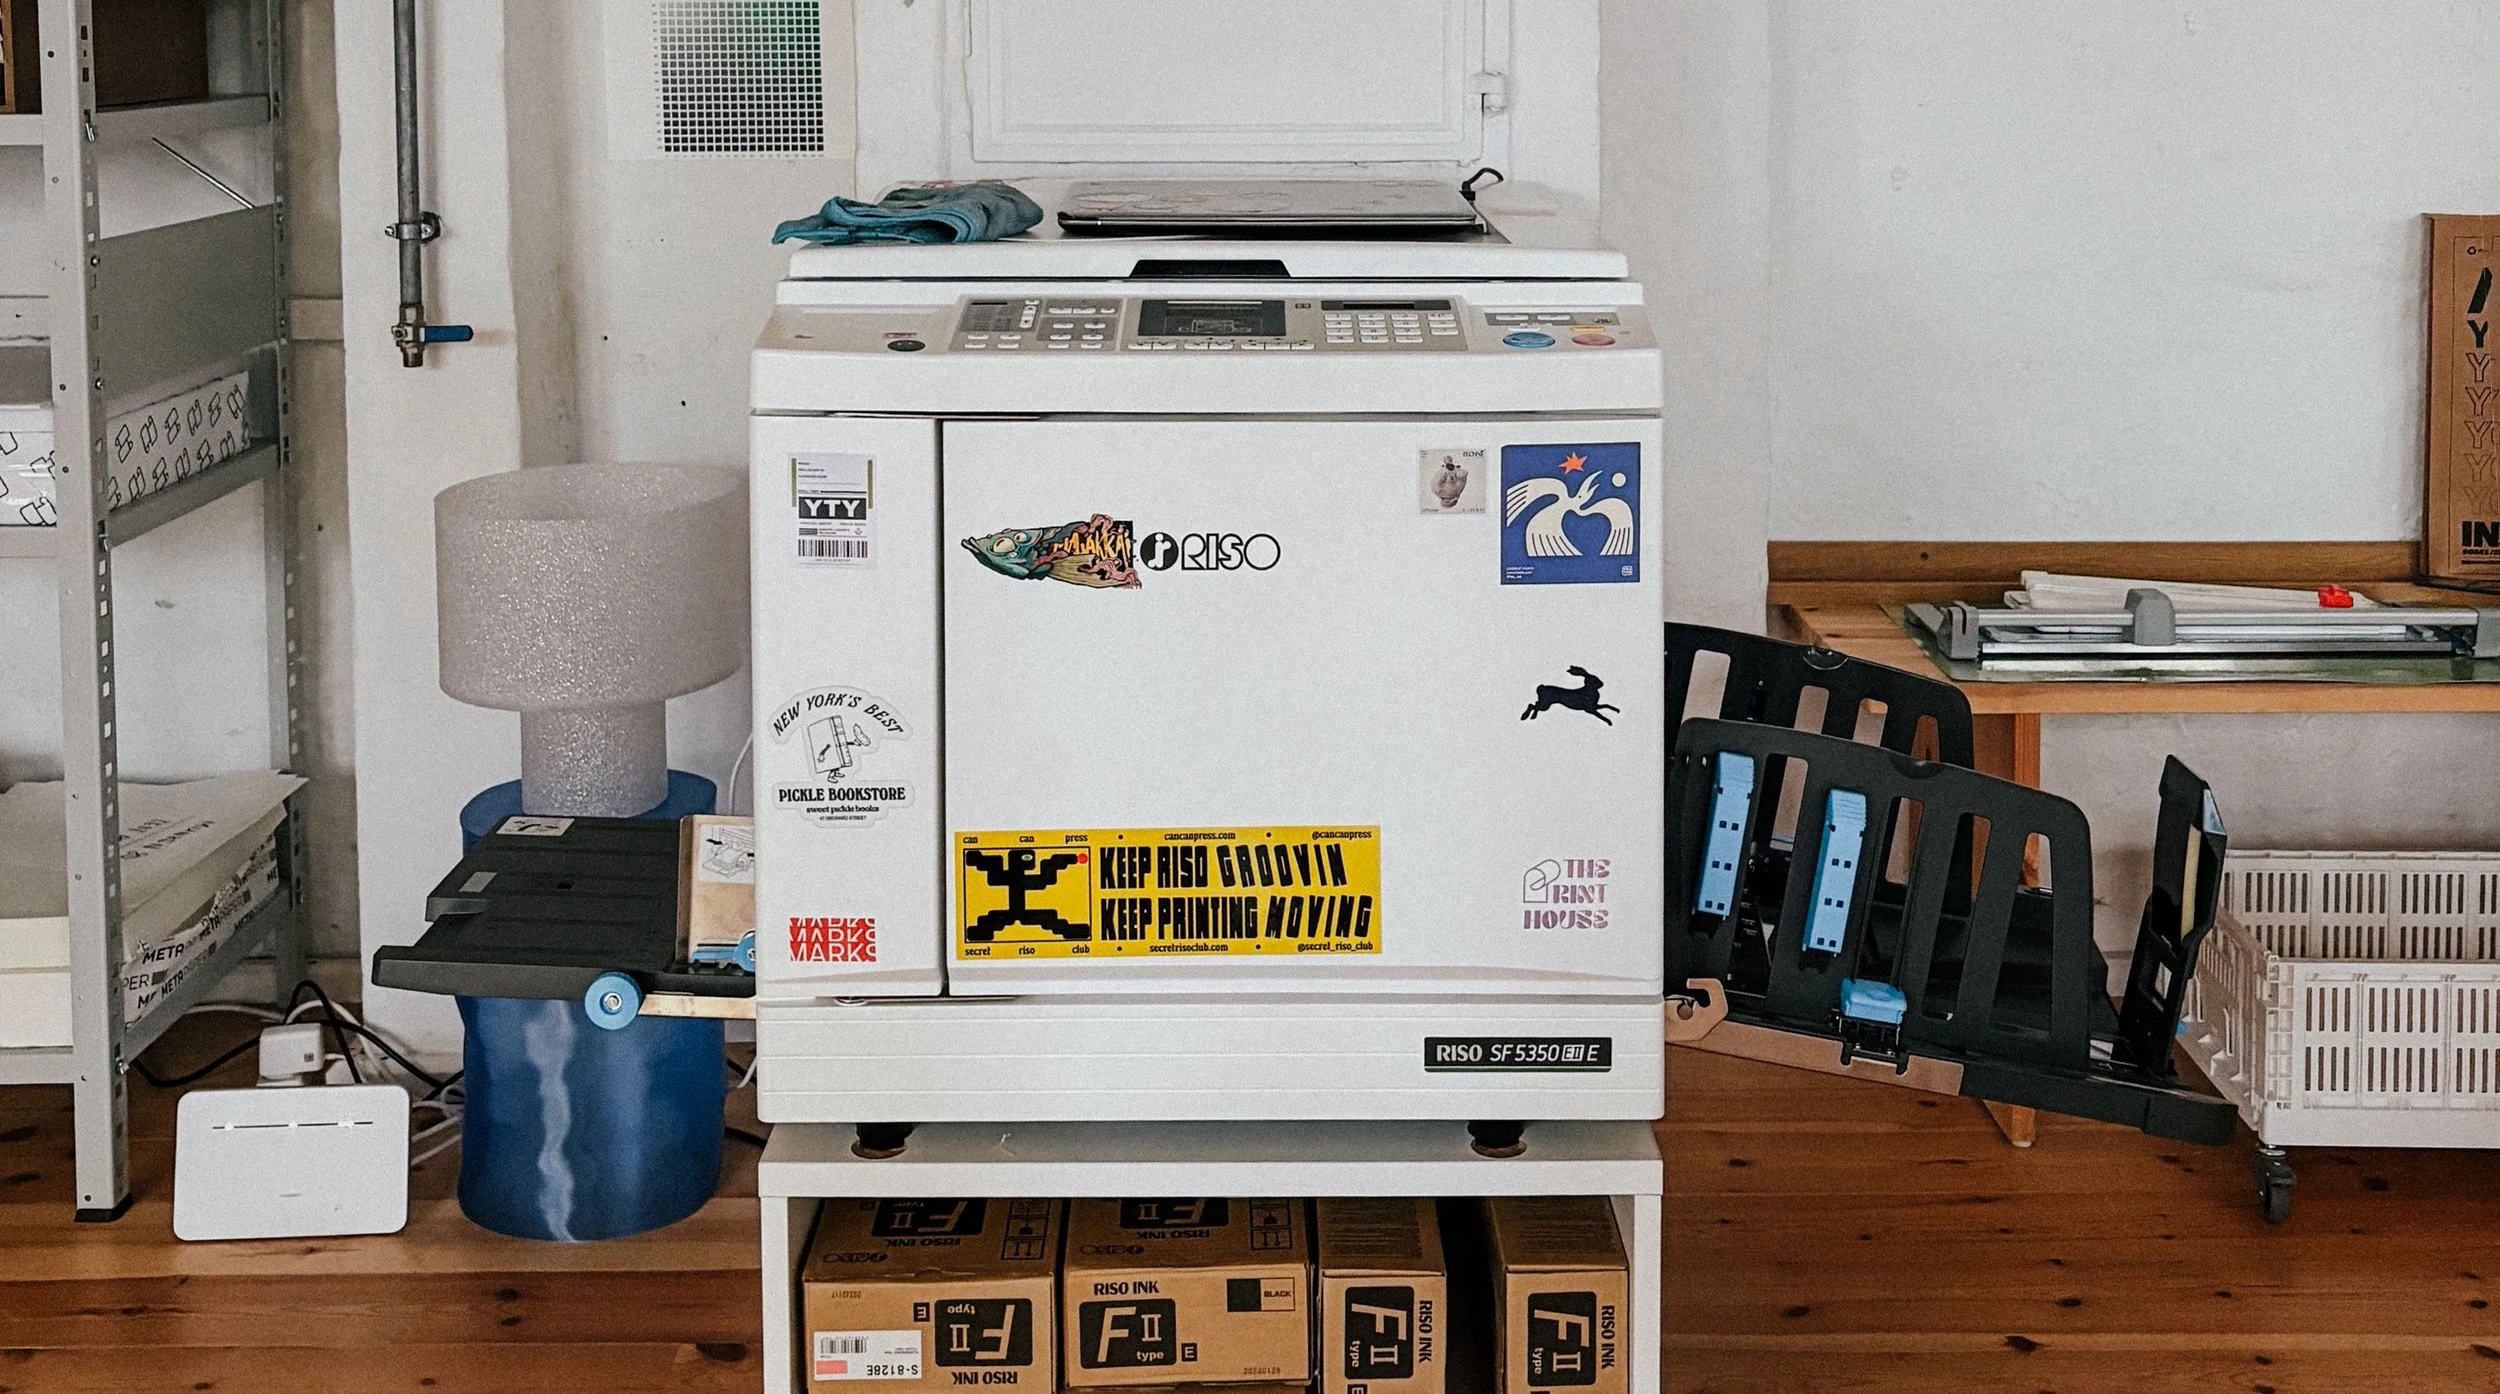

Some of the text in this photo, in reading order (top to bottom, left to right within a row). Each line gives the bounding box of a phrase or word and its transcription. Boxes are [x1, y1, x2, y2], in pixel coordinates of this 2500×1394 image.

[804, 499, 861, 518] YTY
[2462, 521, 2500, 547] IN
[1181, 533, 1281, 571] RISO
[773, 693, 904, 737] NEW YORK'S BEST
[779, 787, 906, 802] PICKLE BOOKSTORE
[806, 804, 879, 814] sweet pickle books
[963, 834, 1088, 844] can can press
[1164, 831, 1236, 842] cancanpress.com
[1311, 830, 1372, 841] @cancanpress
[1100, 843, 1347, 889] KEEP RISO GROOVIN
[1564, 859, 1610, 878] THE
[1100, 895, 1373, 941] KEEP PRINTING MOVING
[1524, 909, 1609, 929] HOUSE
[142, 943, 185, 964] META
[788, 942, 877, 962] MARKS
[964, 945, 1090, 956] secret riso club
[1149, 942, 1228, 953] secretrisoclub.com
[1297, 941, 1373, 952] @secret_riso_club
[1436, 1044, 1483, 1062] RISO
[1136, 1230, 1210, 1240] RISO INK
[886, 1238, 961, 1248] RISO INK
[1093, 1280, 1159, 1296] RISO INK
[1264, 1290, 1292, 1298] BLACK
[917, 1305, 928, 1318] E
[1418, 1300, 1433, 1364] RISO INK
[1601, 1305, 1615, 1370] RISO INK
[1136, 1350, 1165, 1361] type
[1184, 1346, 1195, 1358] E
[1349, 1340, 1362, 1368] type
[1531, 1347, 1544, 1375] type
[867, 1364, 919, 1376] S-8128E
[952, 1371, 1018, 1385] RISO INK
